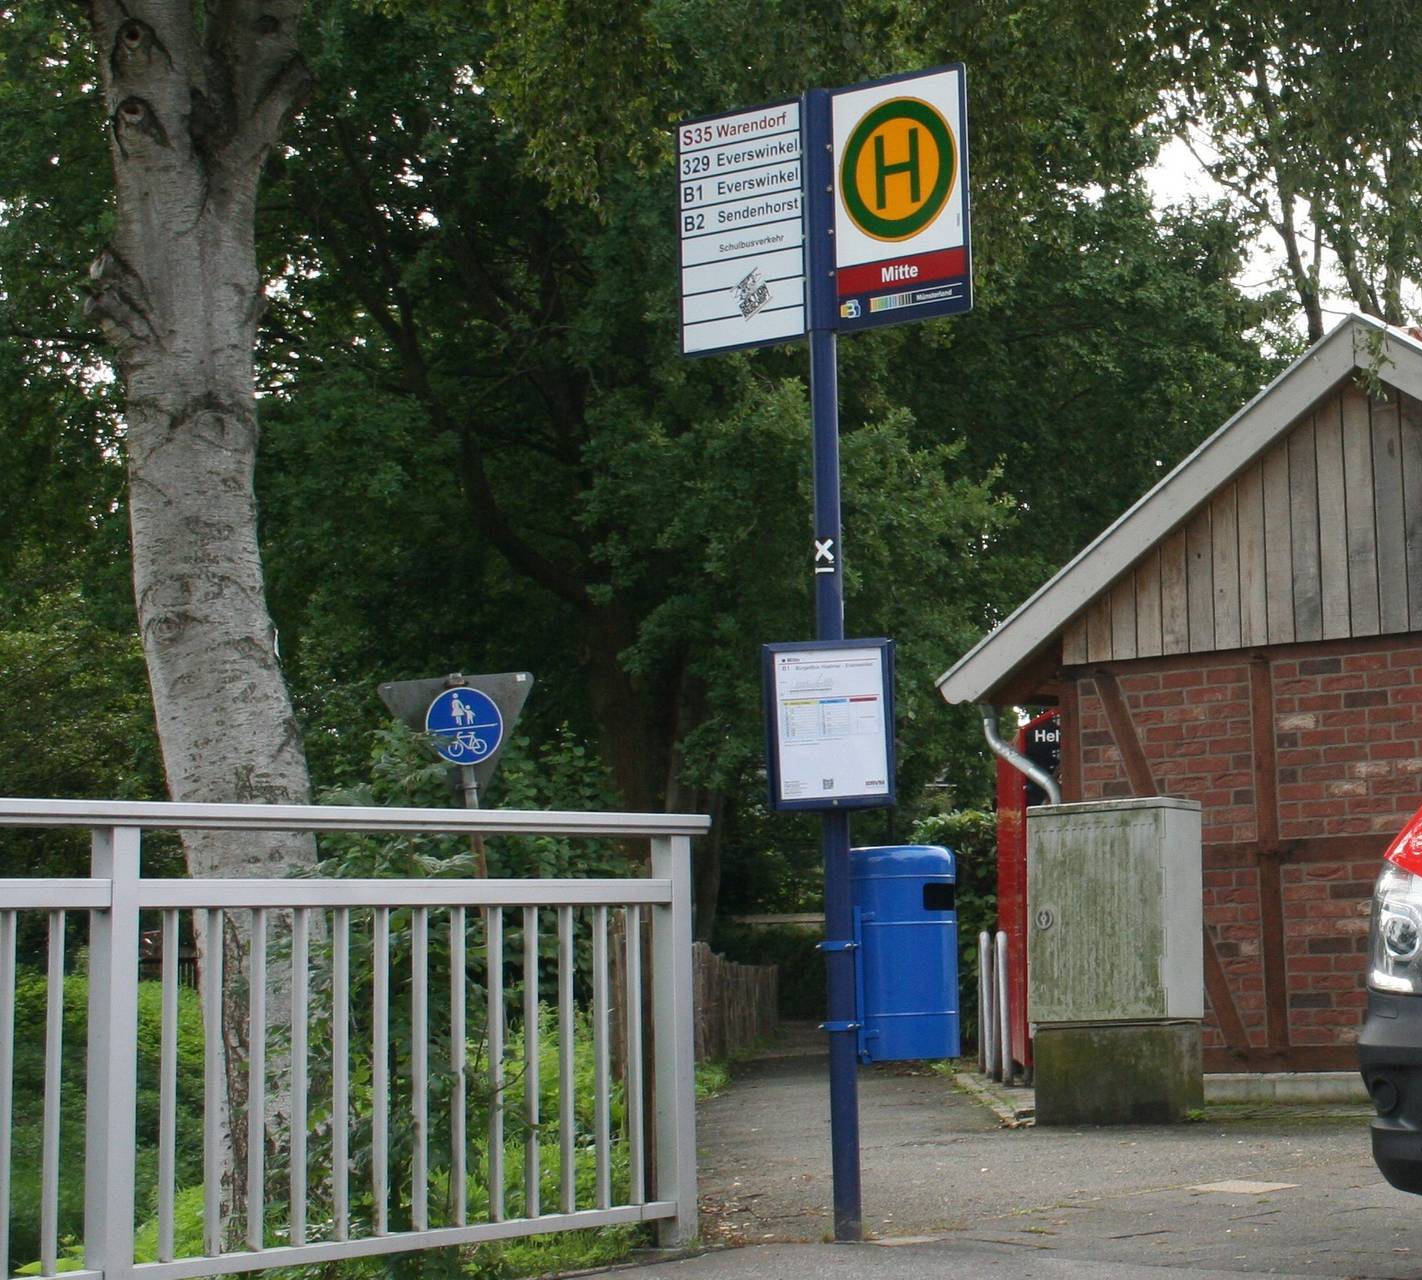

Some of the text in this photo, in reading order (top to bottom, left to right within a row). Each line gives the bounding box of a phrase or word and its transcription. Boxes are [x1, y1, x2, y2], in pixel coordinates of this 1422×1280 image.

[683, 112, 787, 146] S35 Warendorf
[683, 139, 798, 175] 329 Everswinkel
[874, 127, 921, 211] H
[684, 167, 799, 203] B1 Everswinkel
[685, 198, 800, 232] B2 Sendenhorst
[719, 233, 785, 252] Schulbusverkehr
[881, 262, 919, 283] Mitte
